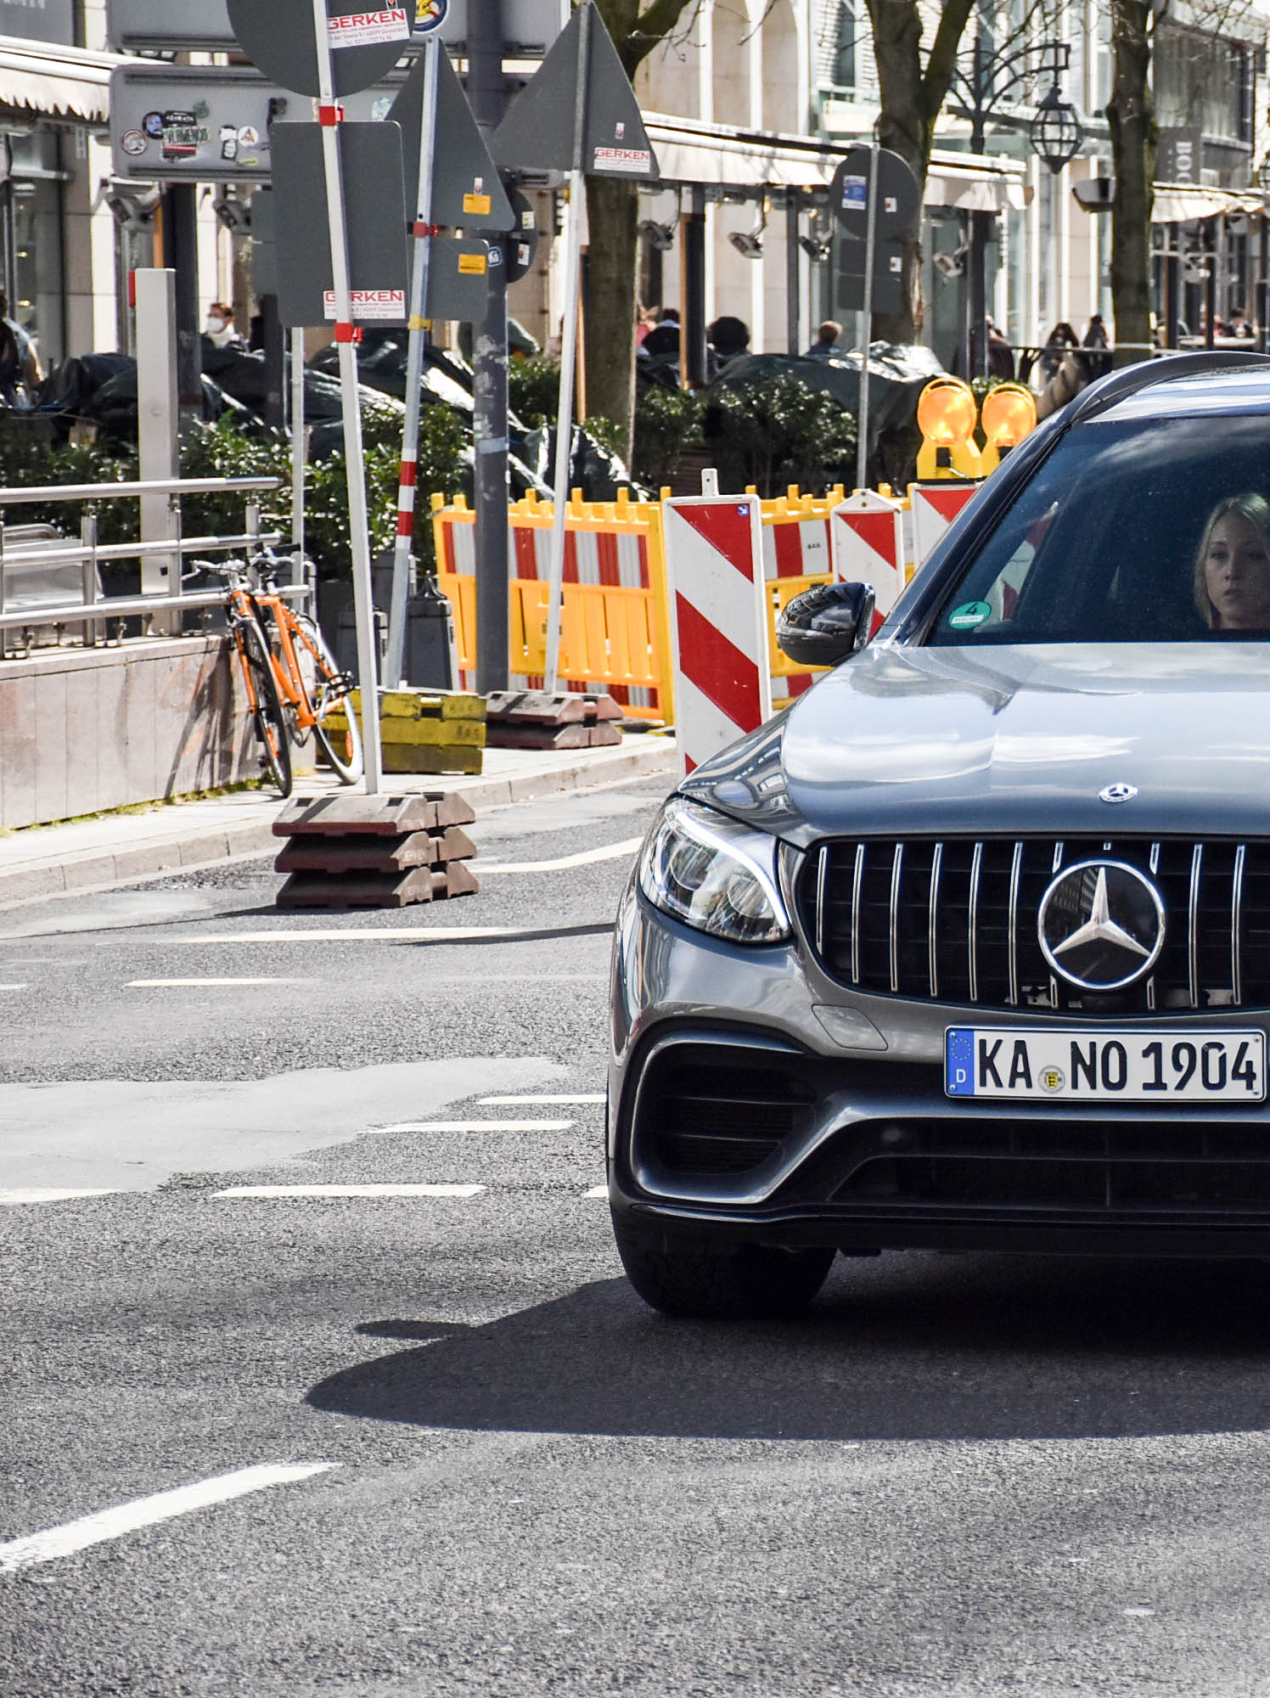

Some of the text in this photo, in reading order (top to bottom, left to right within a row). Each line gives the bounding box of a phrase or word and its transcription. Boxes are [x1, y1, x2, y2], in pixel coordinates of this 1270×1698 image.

[595, 148, 649, 160] GERKEN
[325, 291, 402, 302] GRKEN
[965, 602, 978, 615] 4
[978, 1038, 1033, 1089] KA
[1141, 1041, 1257, 1091] 1904
[956, 1071, 967, 1084] D
